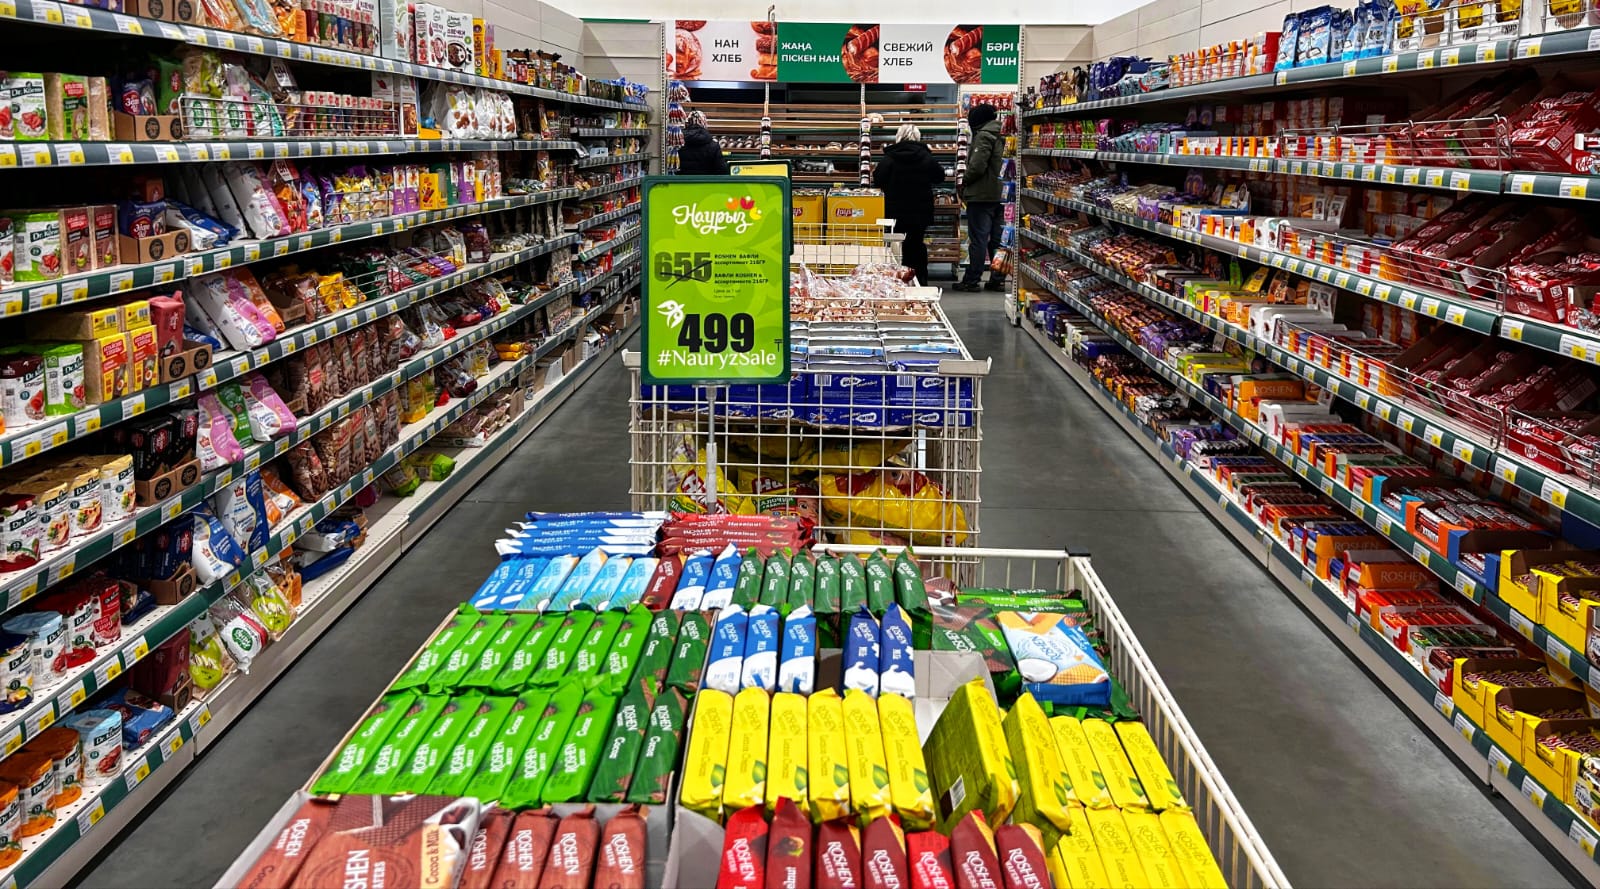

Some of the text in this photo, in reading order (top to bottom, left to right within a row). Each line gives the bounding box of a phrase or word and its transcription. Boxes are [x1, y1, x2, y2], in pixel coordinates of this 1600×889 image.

[712, 54, 742, 63] ХЛЕБ
[714, 39, 739, 48] НАН
[781, 42, 812, 51] ЖАҢА
[883, 41, 933, 52] СВЕЖИЙ
[986, 42, 1014, 52] БӘРІ
[781, 55, 840, 63] ПІСКЕН НАН
[883, 57, 913, 66] ХЛЕБ
[986, 57, 1017, 66] ҮШІН
[672, 203, 754, 235] Наурыз
[654, 252, 712, 282] 655
[678, 313, 755, 353] 499
[657, 349, 776, 370] #NauryzSale
[1253, 383, 1294, 395] ROSHEN
[1380, 570, 1428, 583] ROSHEN
[623, 705, 638, 731] ROSHEN
[656, 705, 672, 731] ROSHEN
[337, 743, 357, 772] ROSHEN
[373, 744, 393, 775] ROSHEN
[411, 743, 430, 774] ROSHEN
[449, 743, 466, 774] ROSHEN
[490, 741, 505, 773] ROSHEN
[523, 747, 538, 779] ROSHEN
[564, 743, 577, 773] ROSHEN
[284, 818, 311, 857] ROSHEN
[427, 830, 439, 847] Milk
[517, 829, 533, 871] ROSHEN
[1070, 824, 1091, 853] OSHEN
[1100, 821, 1131, 854] ROSHEN
[1138, 825, 1171, 858] ROSHEN
[1176, 831, 1211, 866] ROSHEN
[561, 832, 579, 875] ROSHEN
[612, 833, 634, 874] ROSHEN
[734, 838, 756, 881] ROSHEN
[828, 841, 855, 888] ROSHEN
[1008, 848, 1043, 889] ROSHEN
[343, 849, 370, 889] SHEN
[372, 861, 386, 889] AFERS
[425, 856, 440, 885] Cocoa
